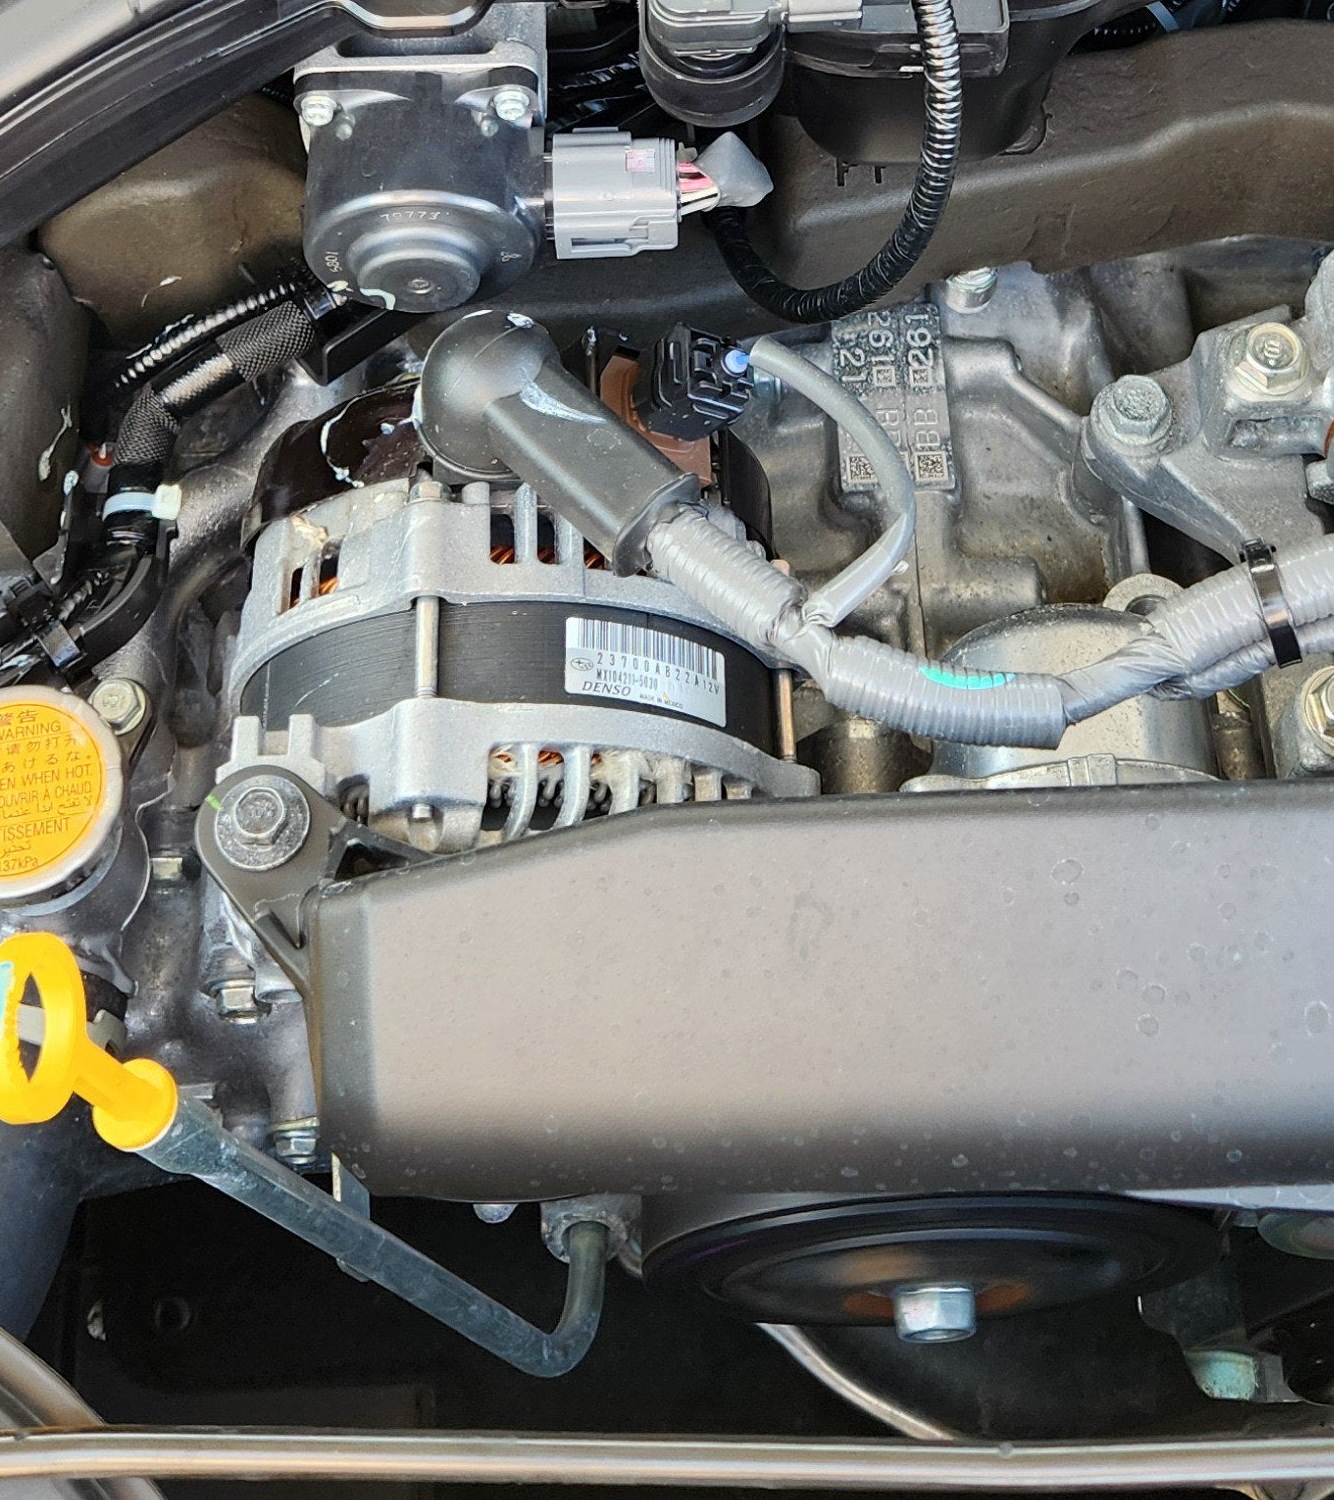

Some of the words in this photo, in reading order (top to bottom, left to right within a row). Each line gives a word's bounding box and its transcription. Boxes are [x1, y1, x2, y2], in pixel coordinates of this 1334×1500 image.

[582, 681, 631, 696] DENSO
[640, 693, 655, 701] MADE
[664, 699, 683, 709] MEXICO
[21, 769, 60, 786] WHEN
[43, 787, 51, 801] À
